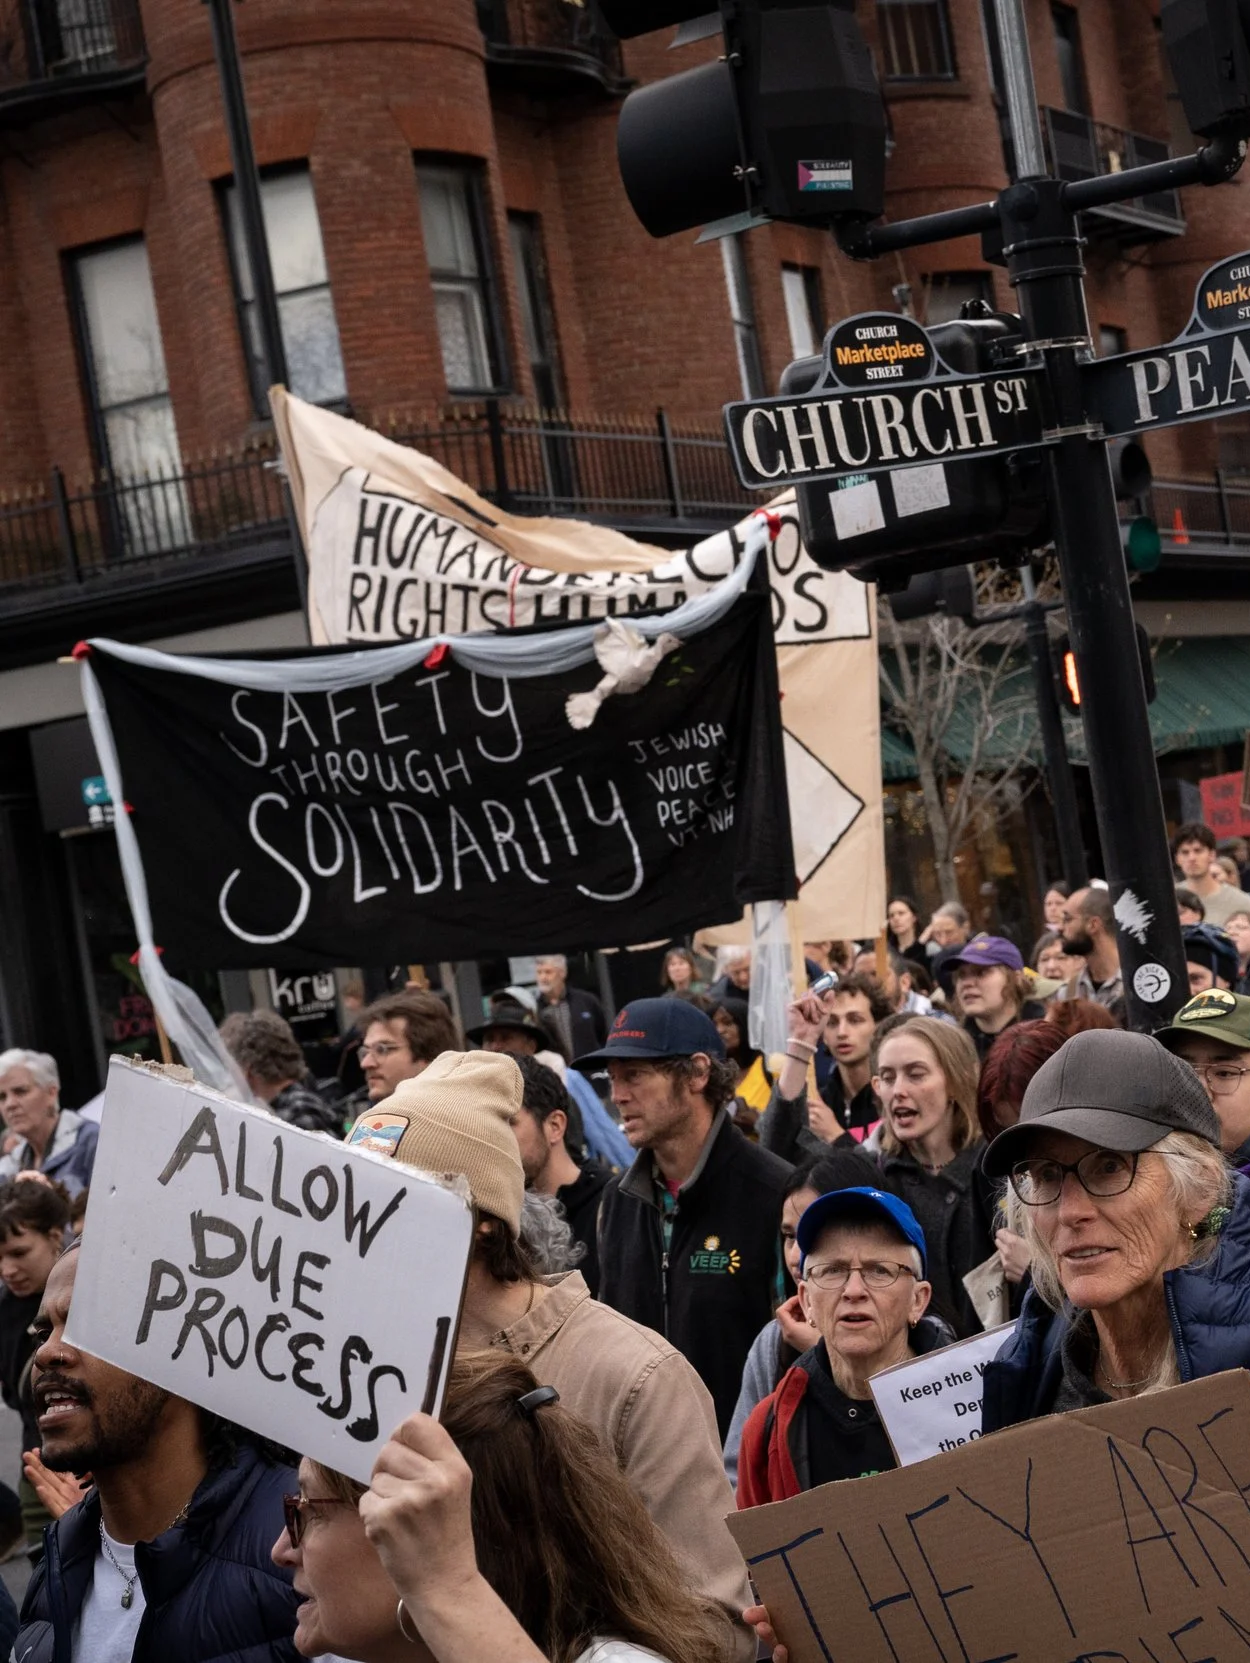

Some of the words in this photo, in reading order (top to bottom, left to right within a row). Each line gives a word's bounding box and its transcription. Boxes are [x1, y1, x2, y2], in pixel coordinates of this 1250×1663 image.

[836, 342, 925, 366] Marketplace
[855, 325, 898, 341] CHURCH
[866, 364, 904, 380] STREET
[742, 382, 998, 478] CHURCH
[994, 377, 1028, 414] ST
[353, 499, 514, 583] HUMAN
[347, 572, 510, 637] RIGHTS
[220, 672, 523, 767] SAFETY
[628, 721, 728, 764] JEWISH
[271, 748, 472, 798] THROUGH
[646, 761, 715, 794] VOICE
[657, 779, 736, 828] PEACE
[220, 767, 644, 945] SOLIDARITY
[158, 1106, 407, 1258] ALLOW
[189, 1209, 331, 1321] DUE
[690, 1255, 730, 1269] VEEP
[135, 1258, 408, 1442] PROCESS
[900, 1381, 943, 1403] Keep
[944, 1370, 973, 1388] the
[938, 1437, 967, 1453] the
[748, 1458, 1077, 1663] THEY
